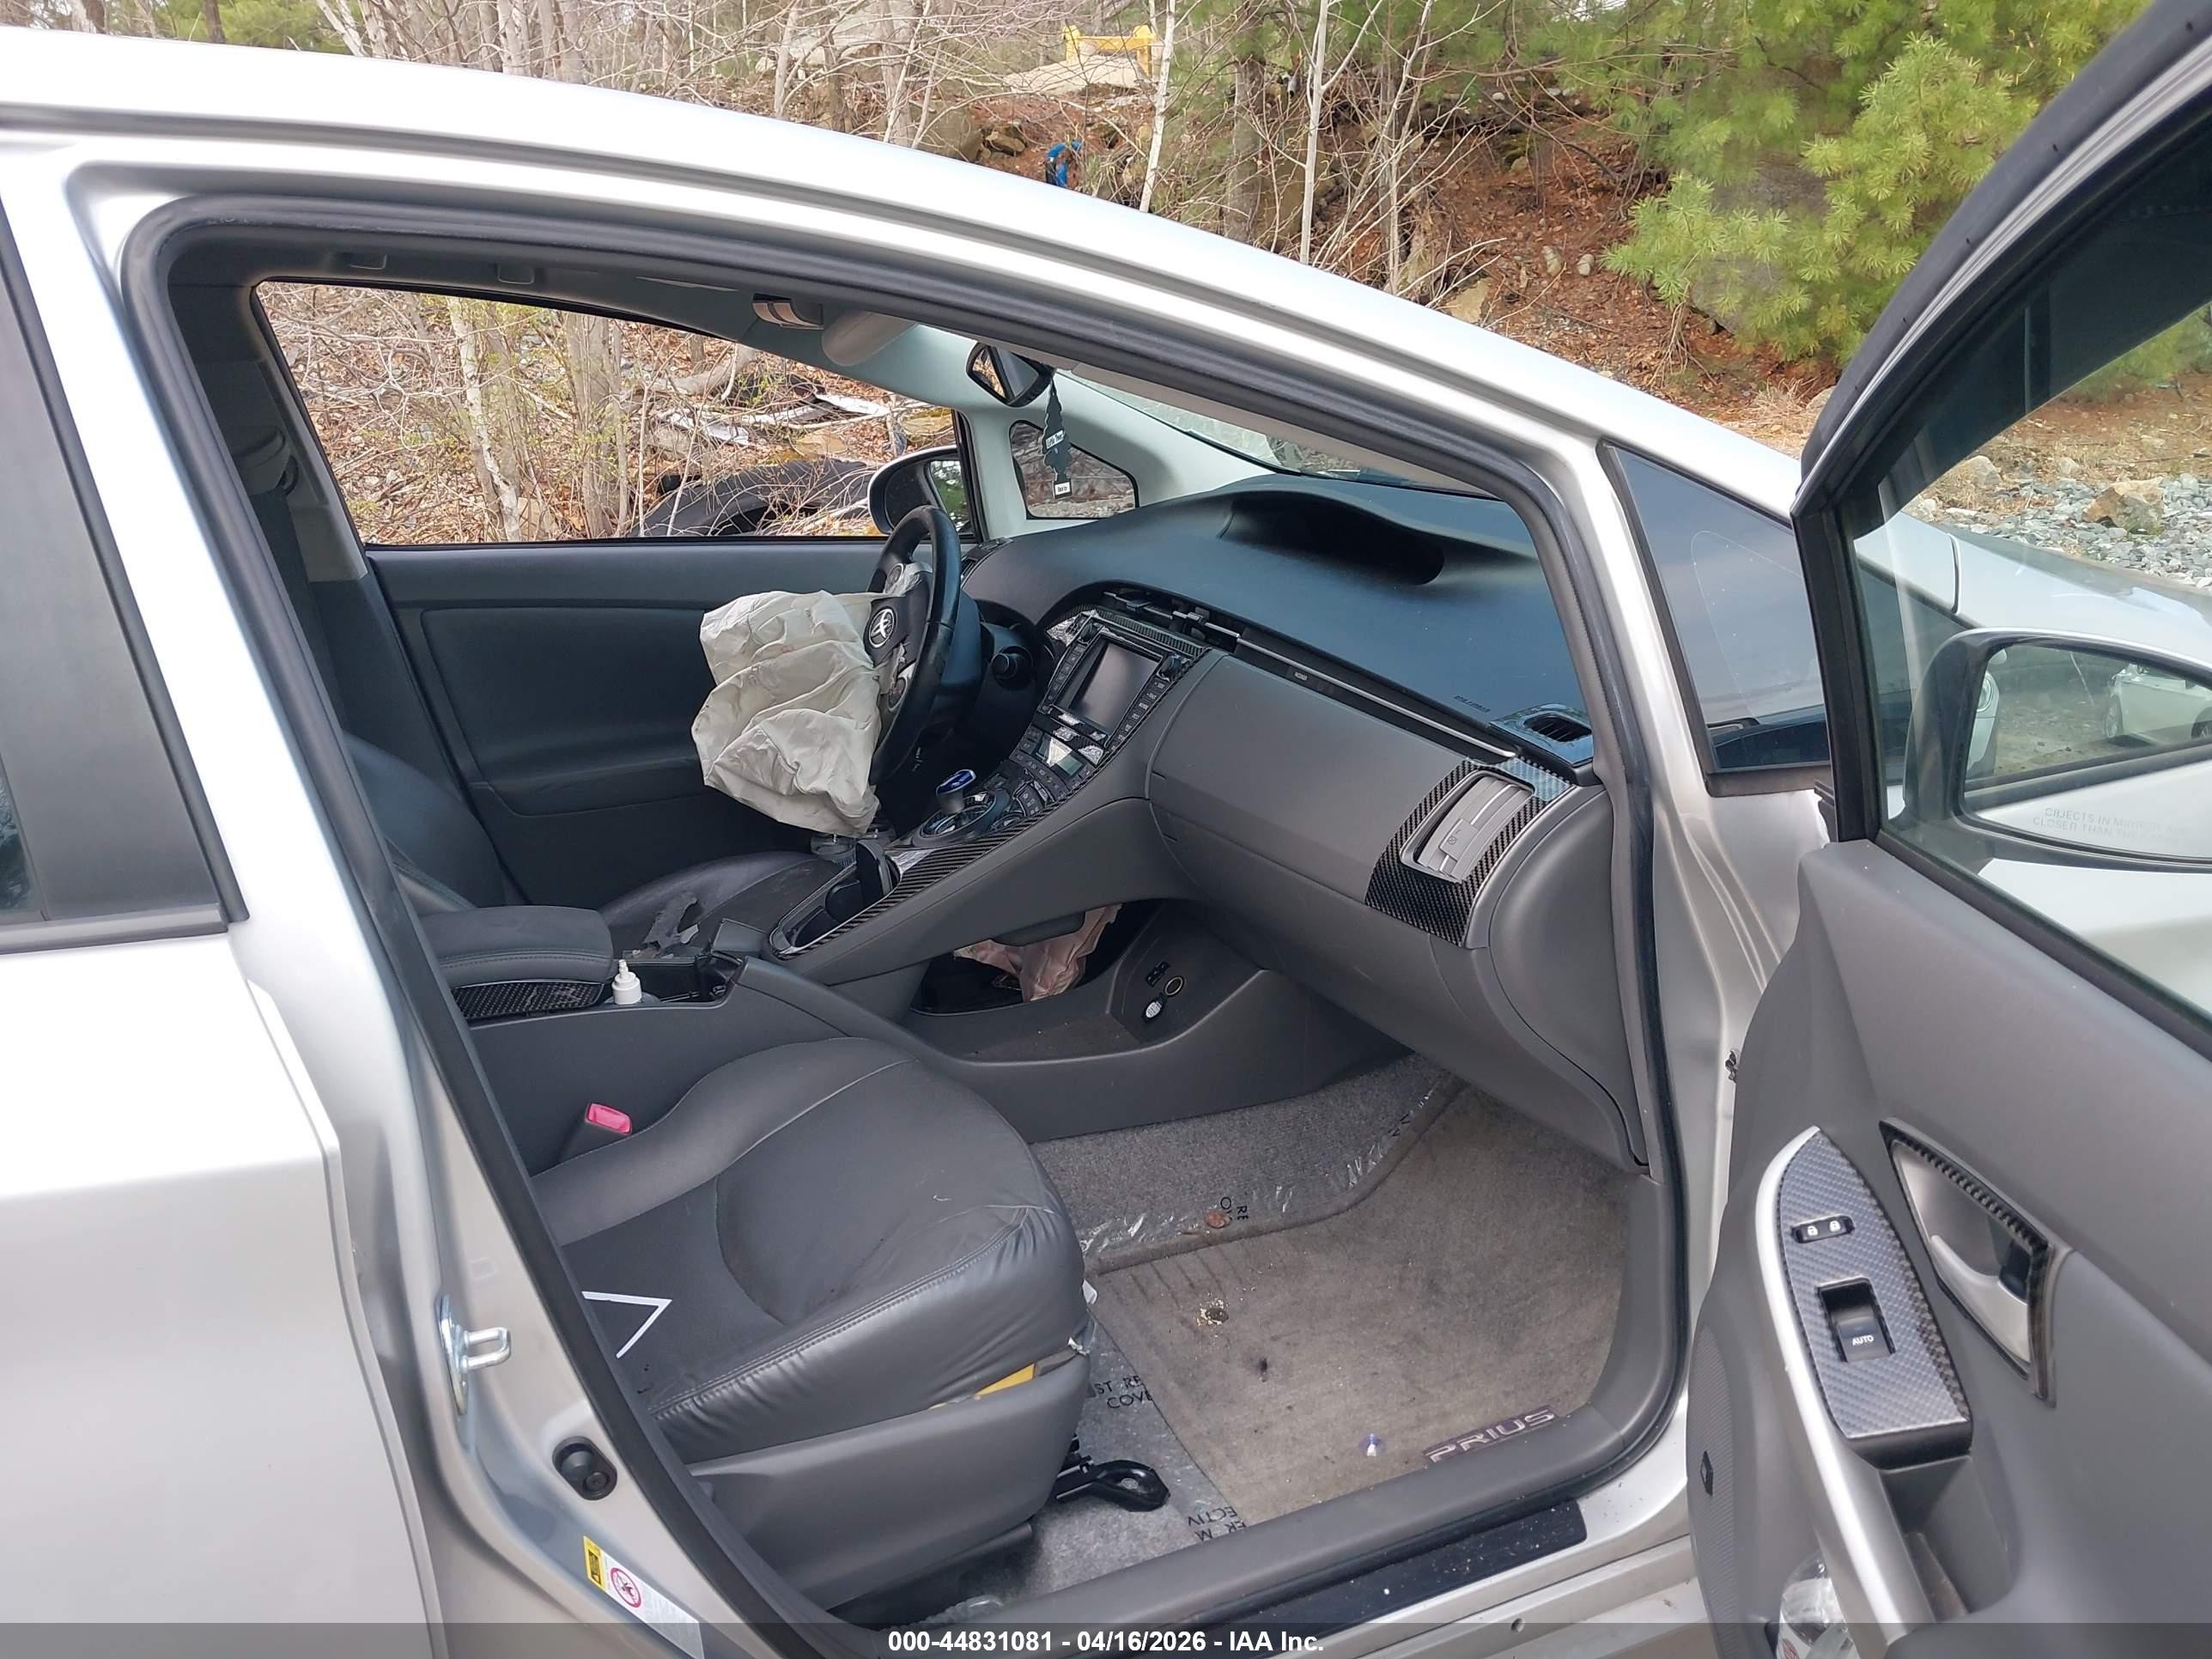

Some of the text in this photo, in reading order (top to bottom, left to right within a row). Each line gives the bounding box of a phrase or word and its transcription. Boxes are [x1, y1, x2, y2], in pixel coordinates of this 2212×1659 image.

[2045, 807, 2095, 823] OBJECTS
[2098, 815, 2111, 825] IN
[2033, 817, 2077, 832] CLOSER
[1852, 1335, 1874, 1346] AUTO
[1425, 1409, 1554, 1463] PRIUS
